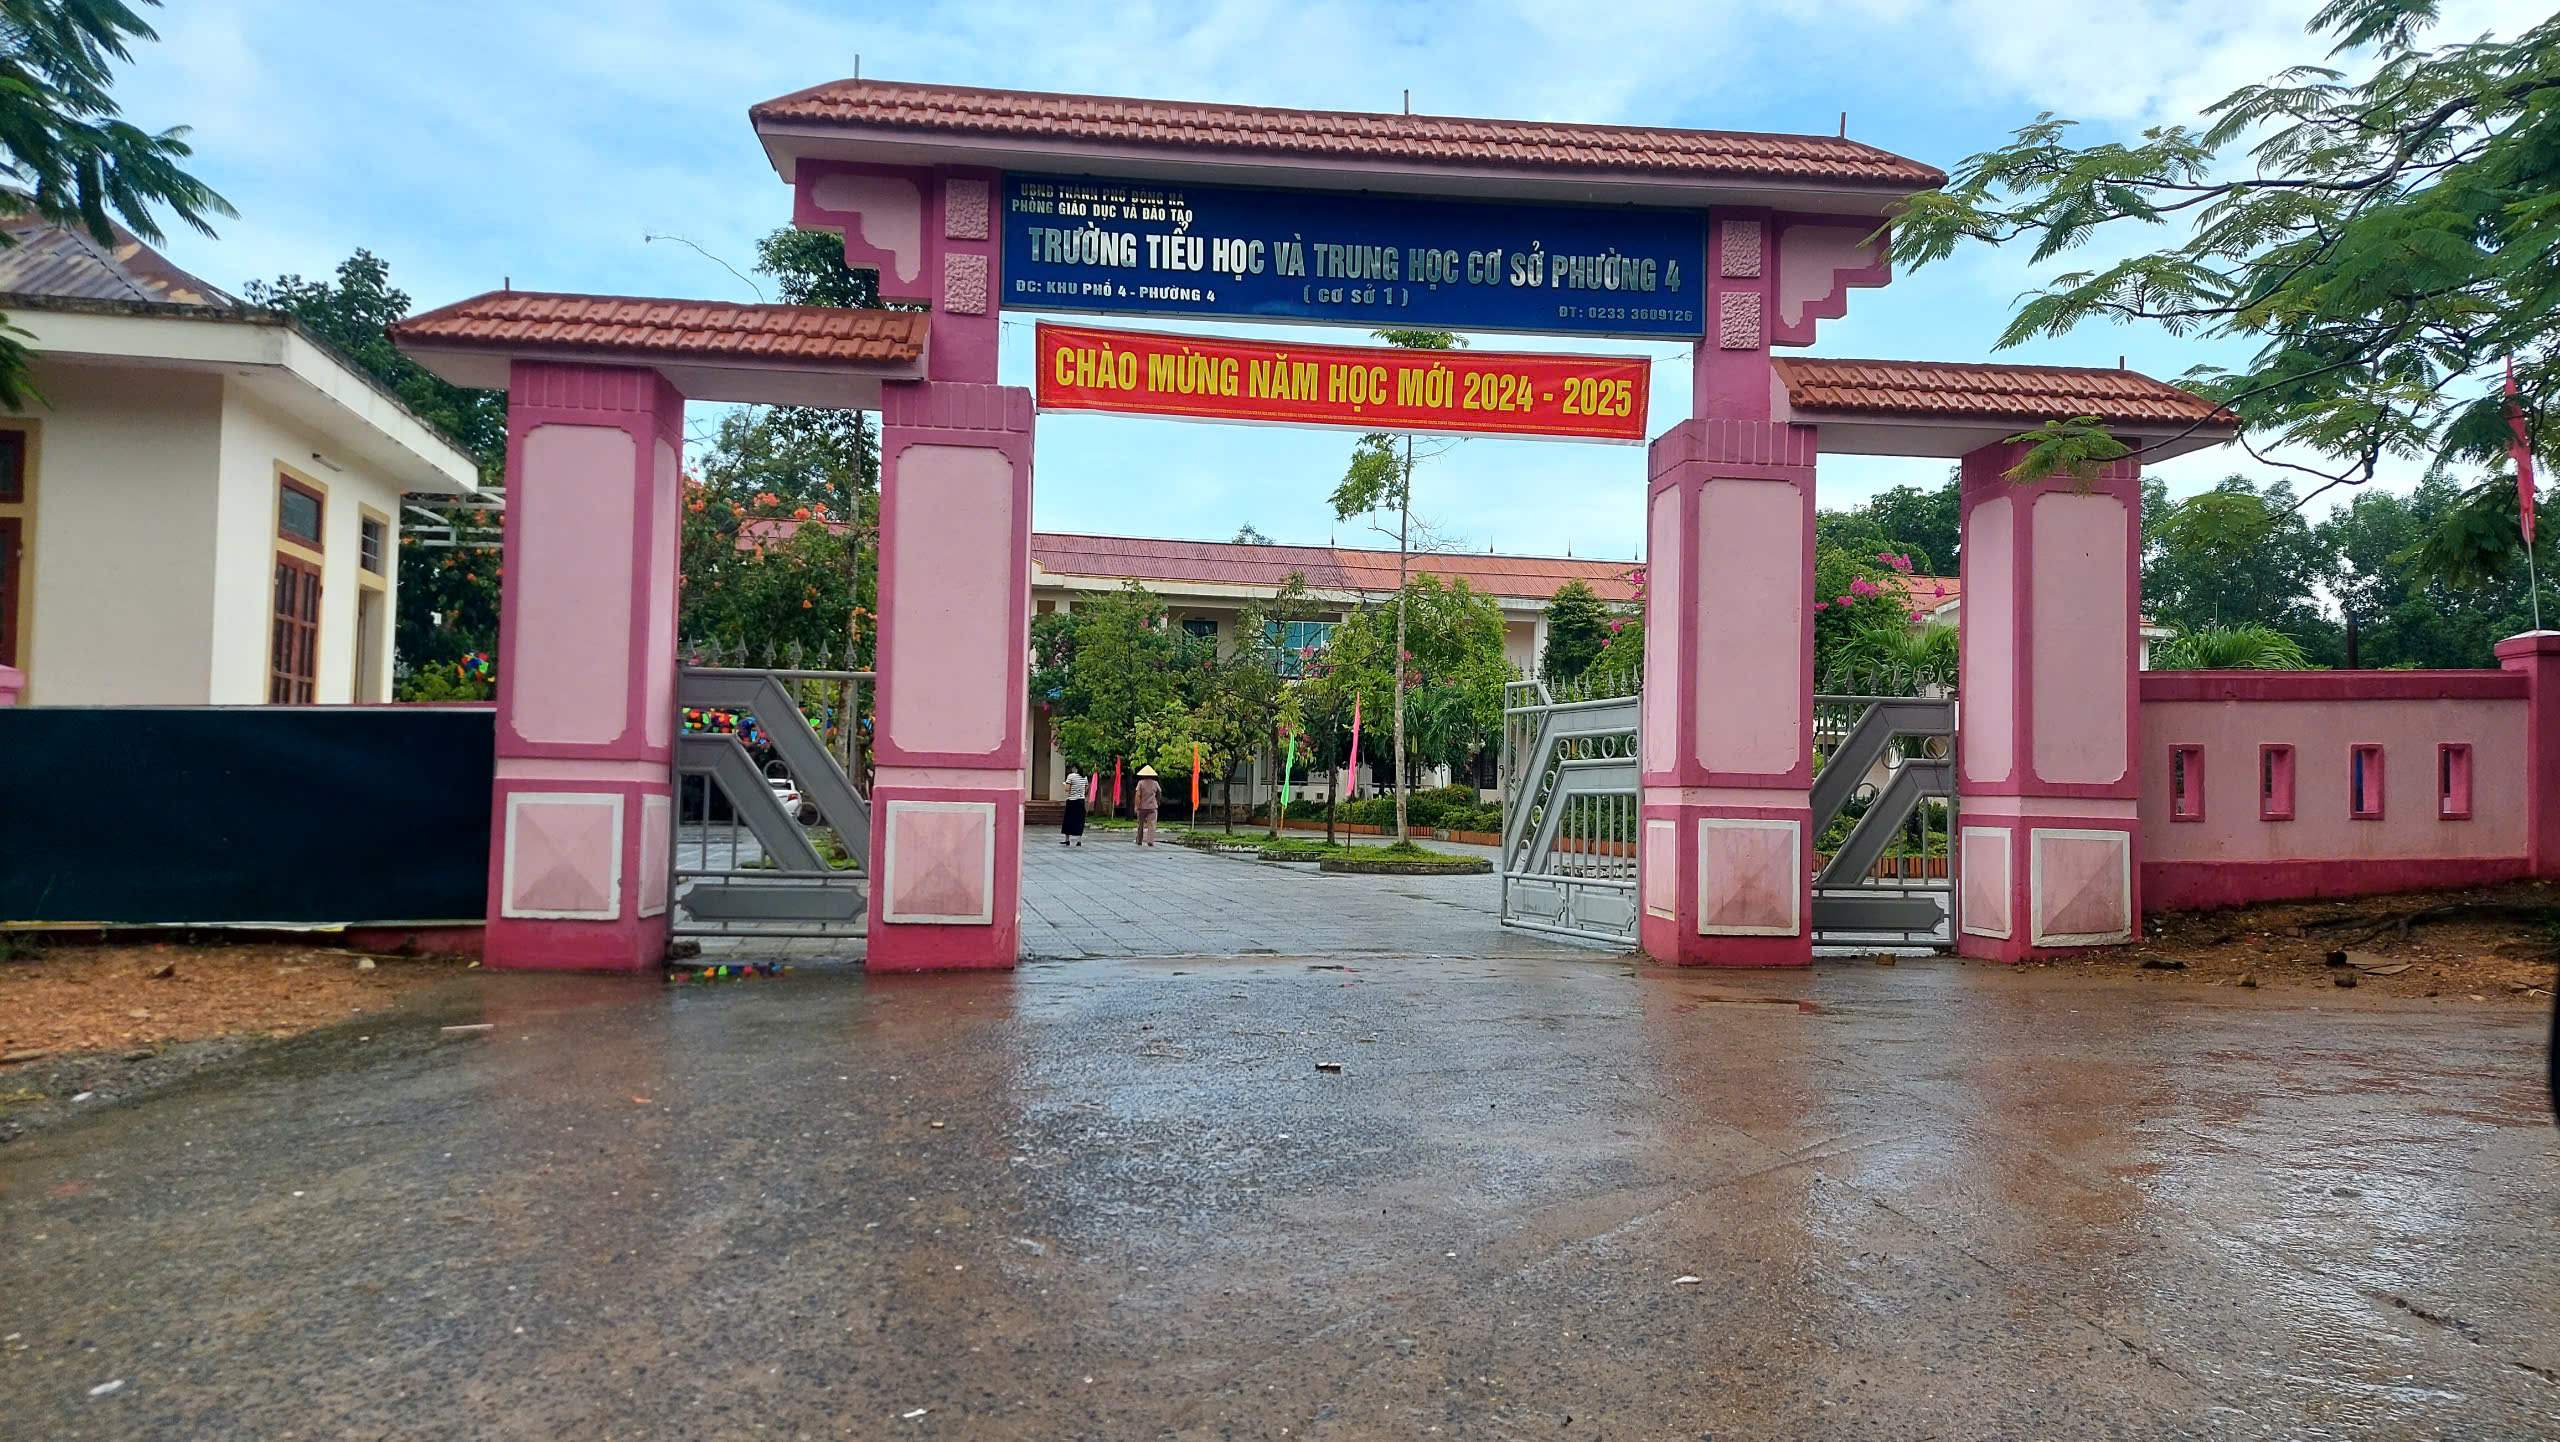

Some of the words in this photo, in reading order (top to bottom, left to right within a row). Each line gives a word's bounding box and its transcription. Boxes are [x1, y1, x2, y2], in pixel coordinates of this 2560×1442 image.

[1021, 183, 1054, 198] UBND
[1058, 183, 1098, 201] THÀNH
[1102, 185, 1127, 202] PHỐ
[1012, 196, 1053, 214] PHÒNG
[1058, 200, 1087, 217] GIÁO
[1093, 204, 1117, 221] DỤC
[1123, 203, 1138, 219] VÀ
[1142, 204, 1166, 221] ĐÀO
[1170, 208, 1193, 225] TẠO
[1028, 221, 1138, 268] TRƯỜNG
[1146, 221, 1204, 272] TIỂU
[1212, 238, 1265, 281] HỌC
[1274, 233, 1306, 277] VÀ
[1313, 243, 1400, 281] TRUNG
[1408, 248, 1459, 290] HỌC
[1468, 248, 1502, 286] CƠ
[1510, 240, 1545, 288] SỞ
[1552, 247, 1657, 292] PHƯỜNG
[1665, 259, 1681, 293] 4
[1016, 279, 1042, 293] ĐC:
[1046, 281, 1078, 295] KHU
[1082, 278, 1112, 297] PHỐ
[1117, 285, 1127, 298] 4
[1139, 284, 1201, 301] PHƯỜNG
[1206, 290, 1216, 302] 4
[1588, 307, 1625, 320] 0233
[1631, 308, 1693, 322] 3609126
[1055, 341, 1137, 390] CHÀO
[1148, 346, 1239, 397] MỪNG
[1249, 353, 1319, 401] NĂM
[1328, 363, 1387, 413] HỌC
[1398, 361, 1454, 408] MỚI
[1463, 371, 1534, 412] 2024
[1543, 392, 1554, 401] -
[1562, 376, 1633, 417] 2025
